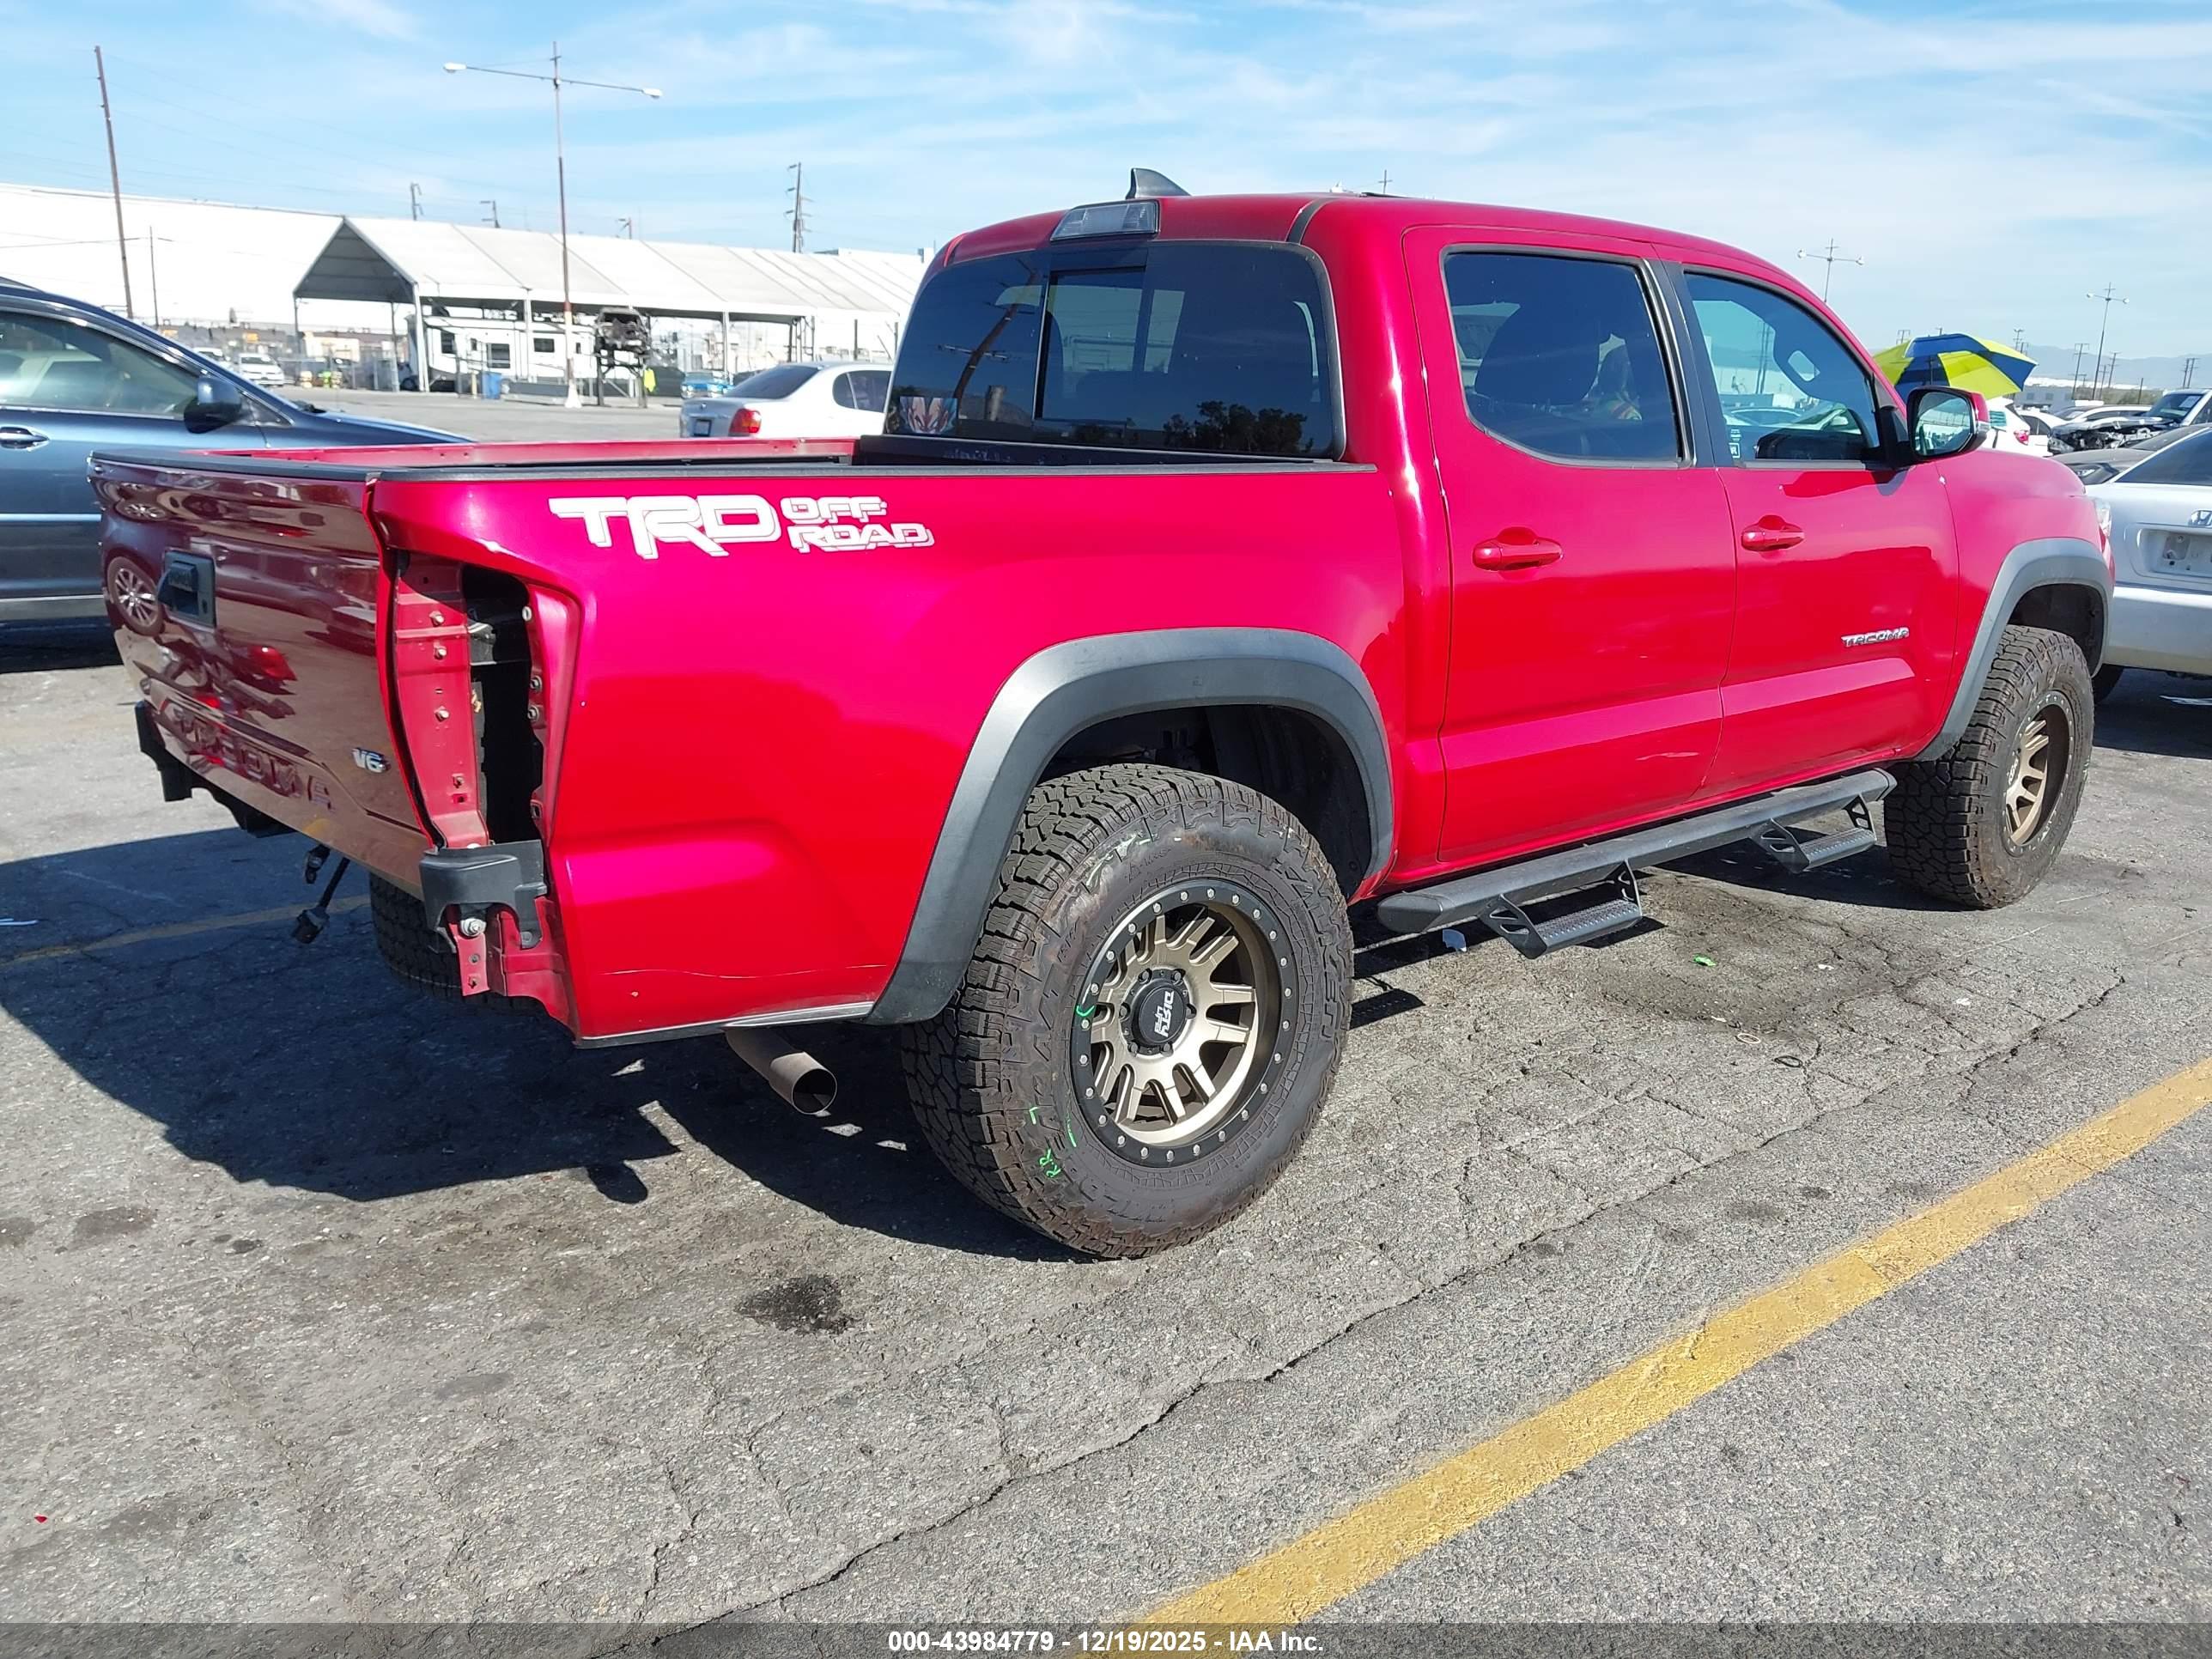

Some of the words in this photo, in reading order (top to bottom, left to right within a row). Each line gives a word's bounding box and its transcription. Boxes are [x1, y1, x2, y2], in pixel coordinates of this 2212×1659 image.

[781, 496, 887, 525] OFF
[549, 495, 781, 560] TRD
[787, 523, 935, 554] ROAD
[1840, 626, 1910, 647] TACOMA
[351, 747, 386, 773] V6
[1155, 990, 1175, 1037] DIRTY
